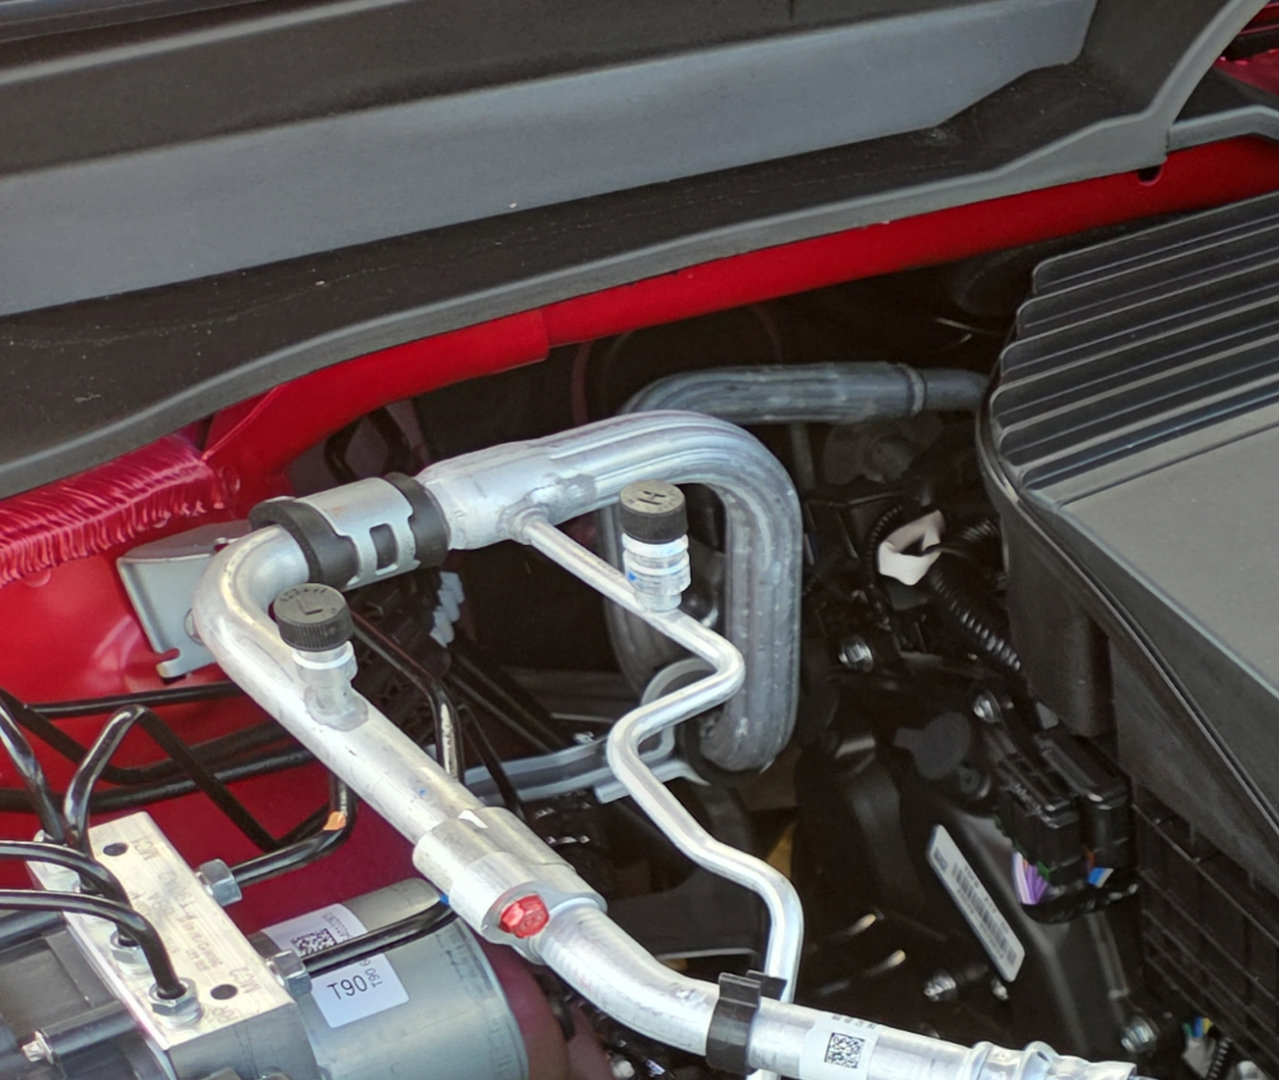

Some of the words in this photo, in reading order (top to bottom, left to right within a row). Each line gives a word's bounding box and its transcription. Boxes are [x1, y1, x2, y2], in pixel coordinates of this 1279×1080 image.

[295, 599, 324, 616] L
[326, 974, 368, 1001] T90
[364, 967, 383, 989] T90
